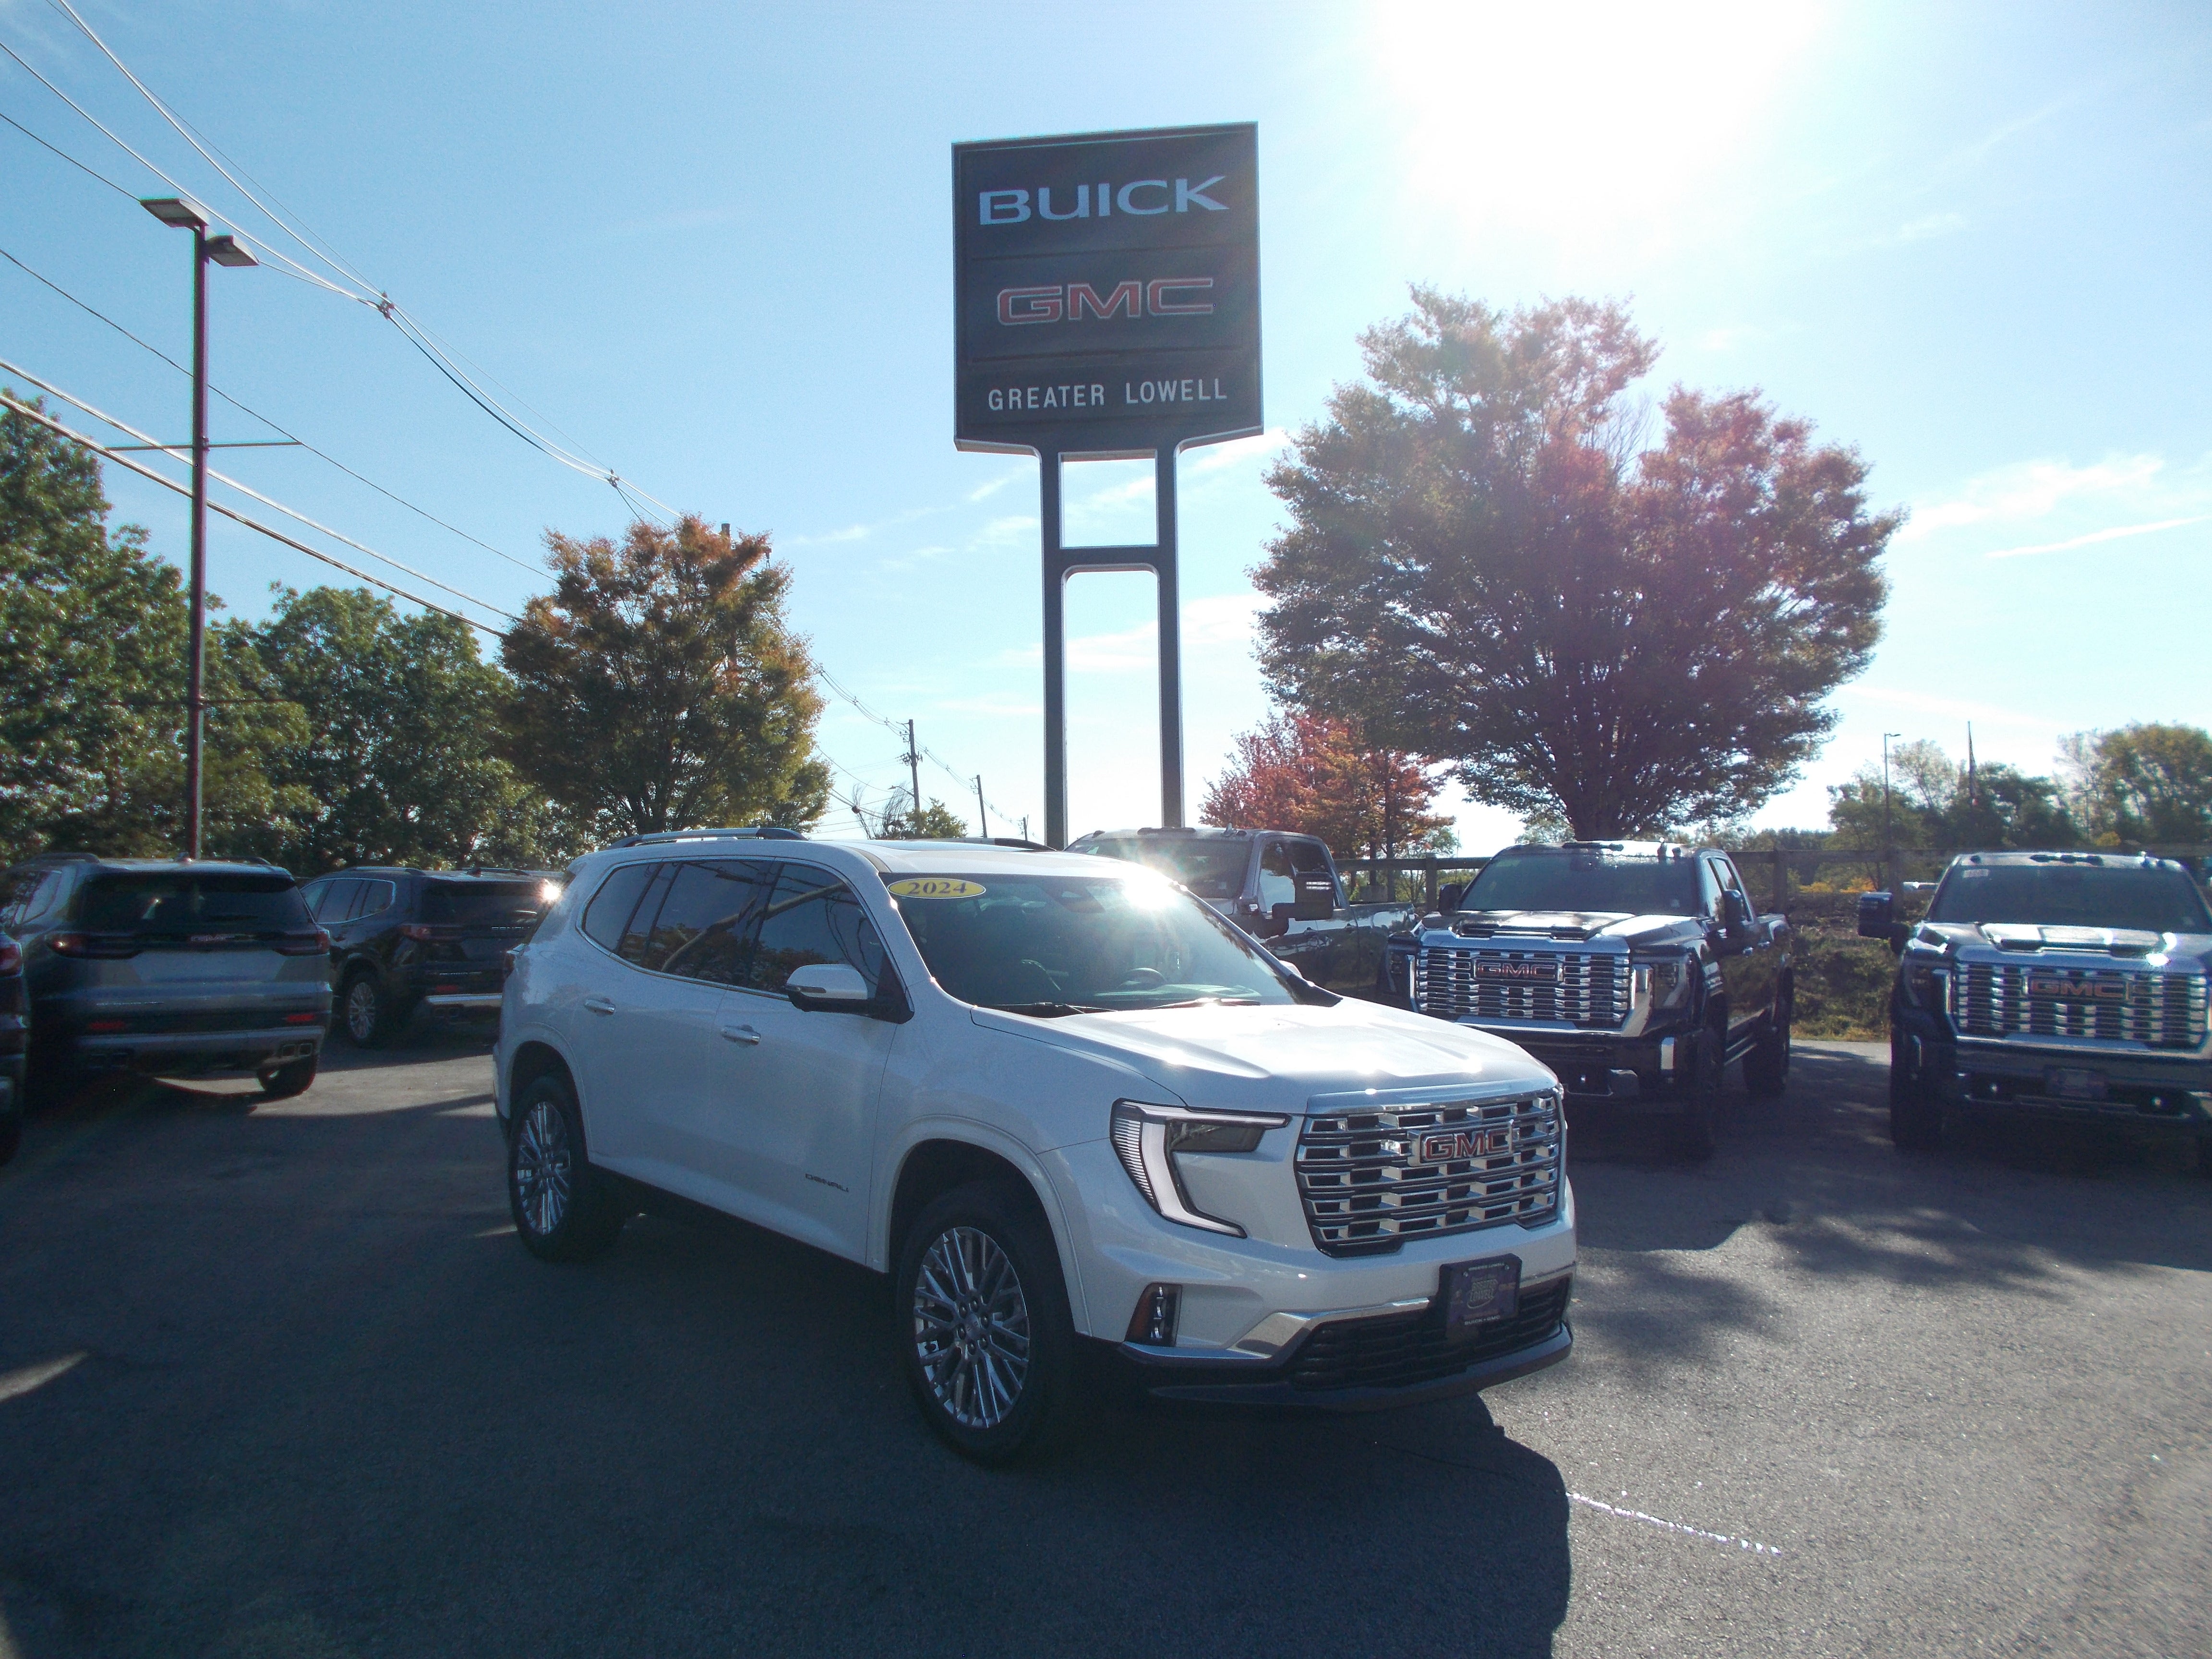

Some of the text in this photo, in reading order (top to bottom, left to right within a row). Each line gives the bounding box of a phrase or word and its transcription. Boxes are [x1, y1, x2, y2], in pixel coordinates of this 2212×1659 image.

[979, 176, 1229, 225] BUICK
[997, 277, 1214, 326] GMC
[988, 378, 1227, 411] GREATER LOWELL
[907, 882, 967, 895] 2024
[1478, 962, 1555, 978] GMC
[2031, 979, 2124, 998] GMC
[1425, 1128, 1510, 1161] GMC
